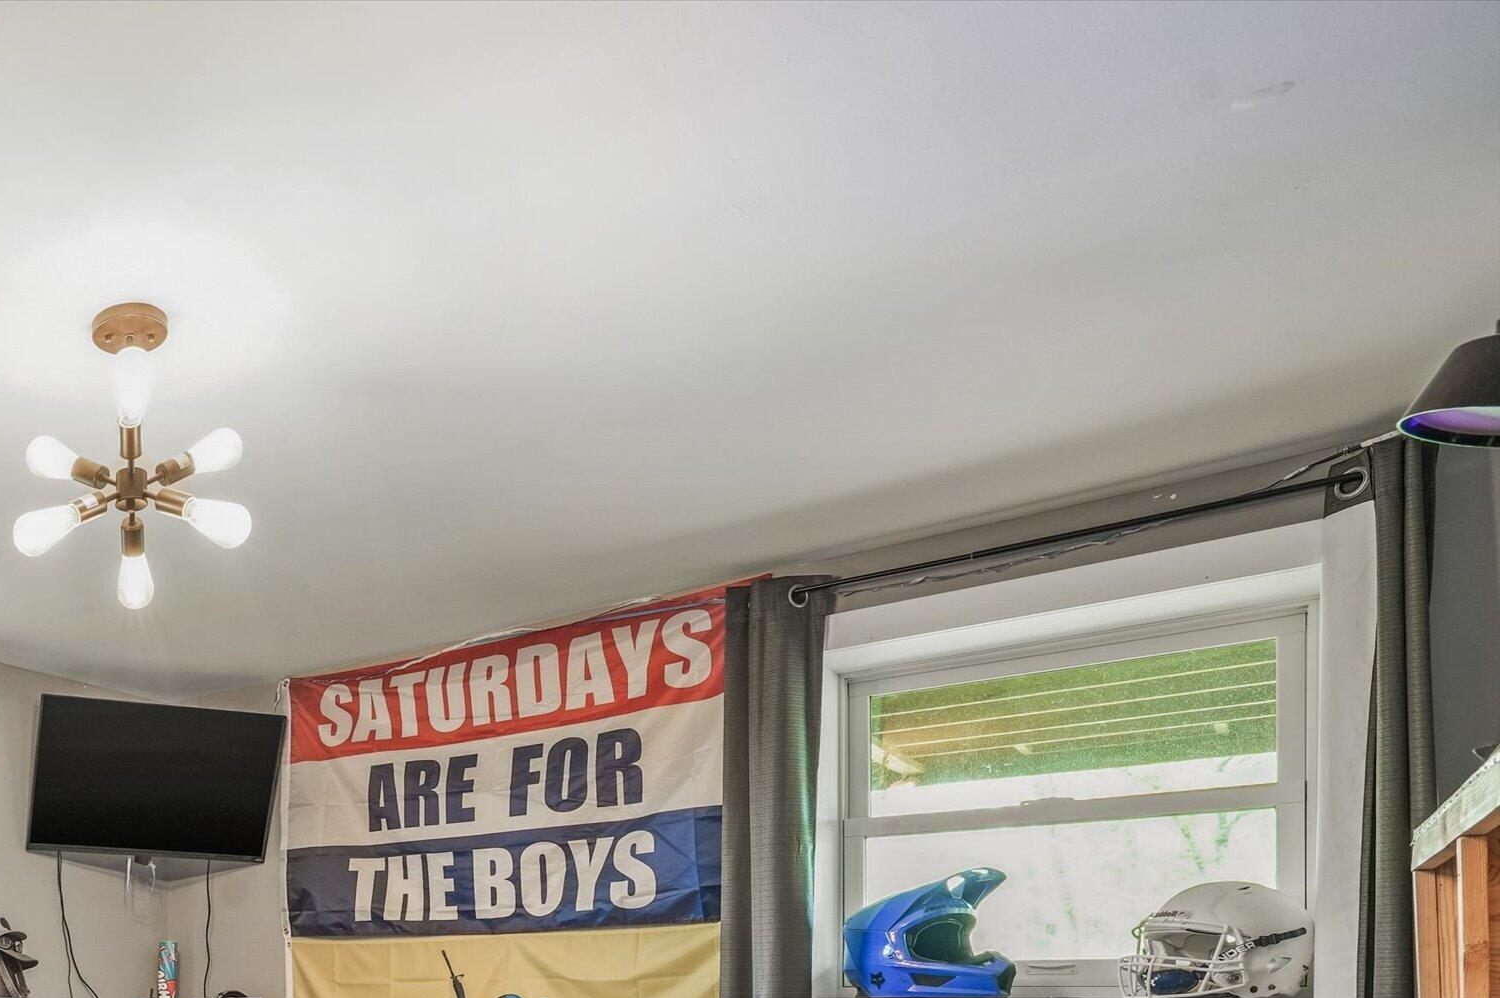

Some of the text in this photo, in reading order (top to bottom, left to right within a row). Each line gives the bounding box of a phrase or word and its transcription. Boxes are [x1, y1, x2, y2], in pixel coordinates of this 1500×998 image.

[318, 608, 712, 748] SATURDAYS
[368, 727, 644, 833] ARE FOR
[347, 829, 657, 922] THE BOYS
[1217, 941, 1256, 960] NDER
